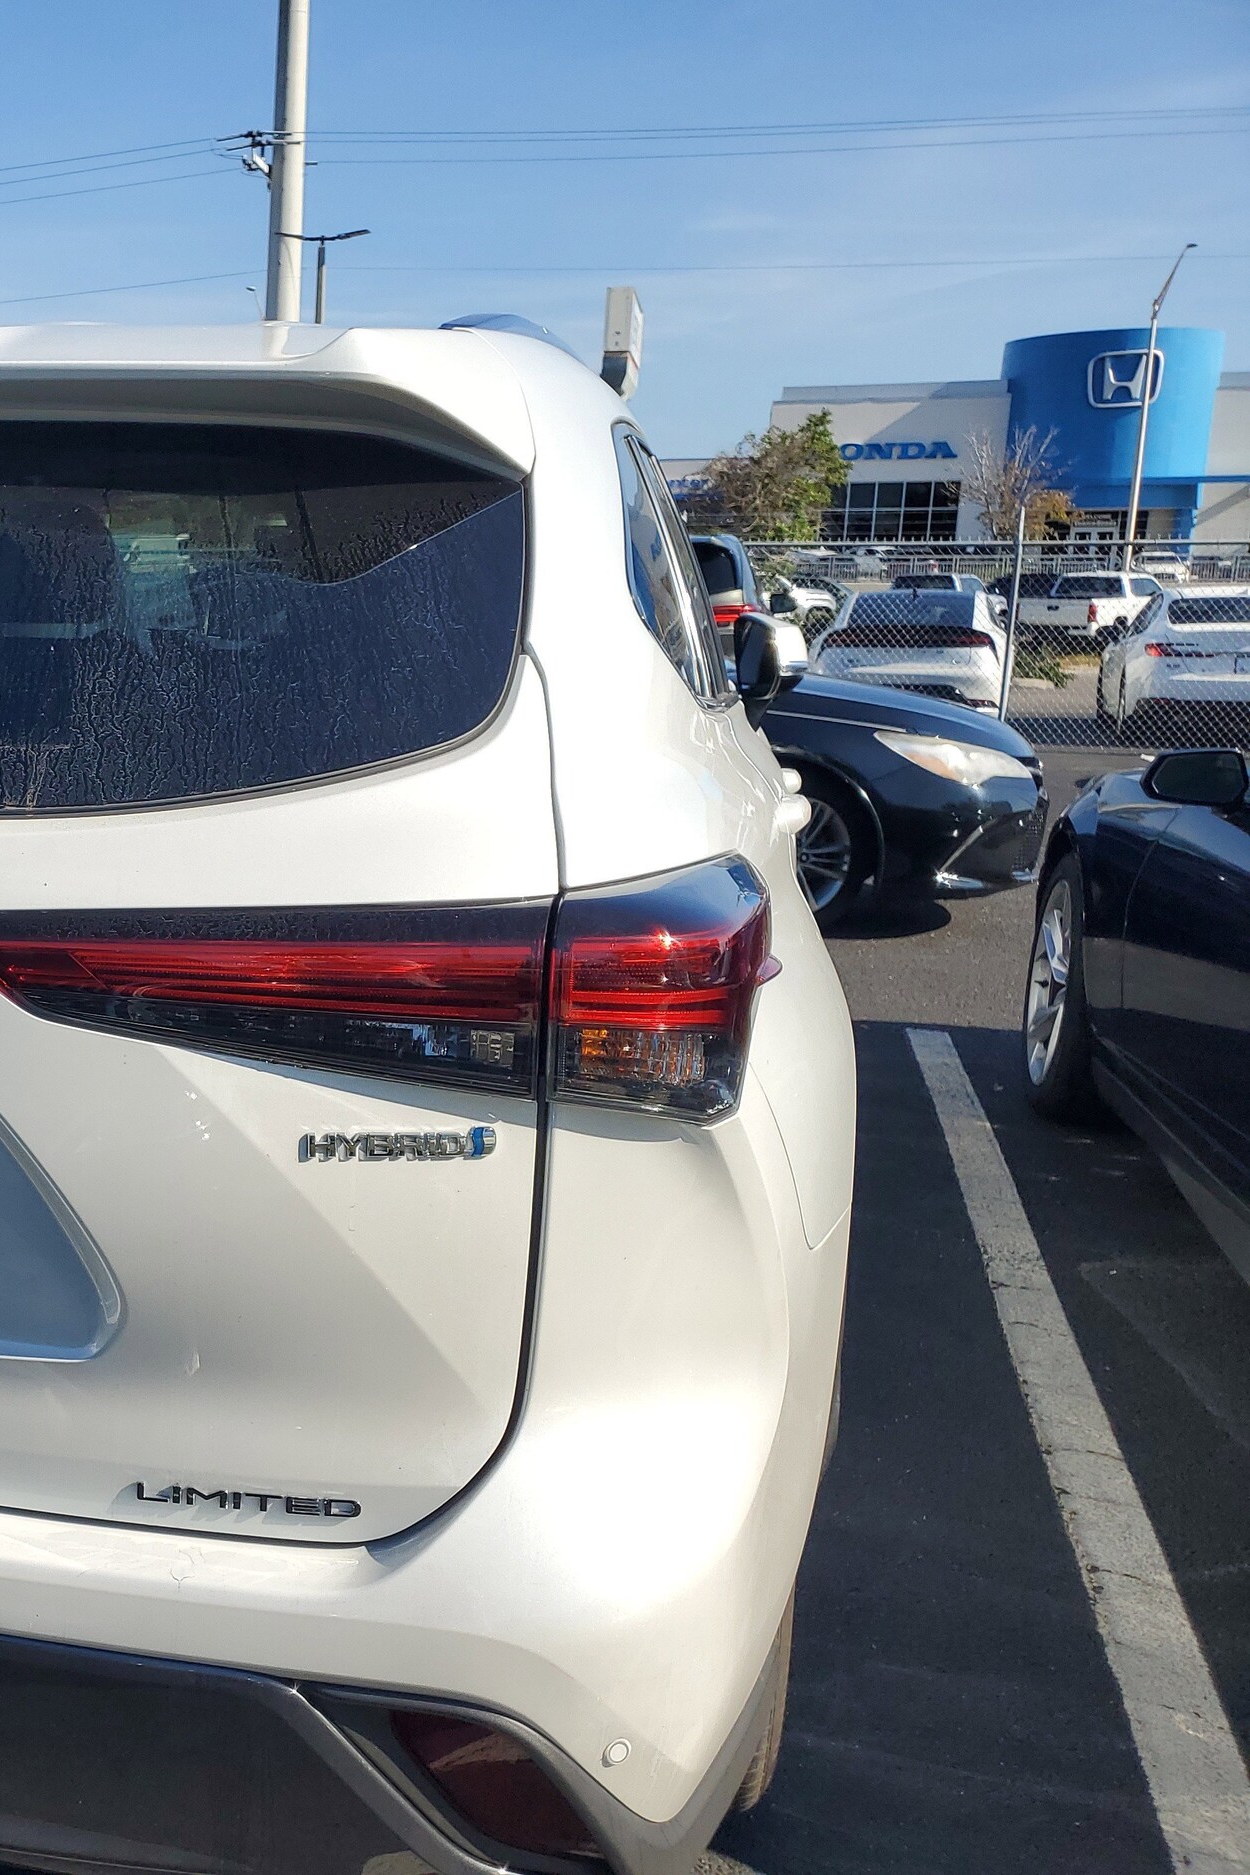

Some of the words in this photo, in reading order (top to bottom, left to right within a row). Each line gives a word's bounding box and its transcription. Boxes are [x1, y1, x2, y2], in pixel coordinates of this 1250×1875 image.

[838, 441, 958, 460] ONDA
[306, 1131, 467, 1160] HYBRID
[136, 1481, 362, 1518] LIMITED
